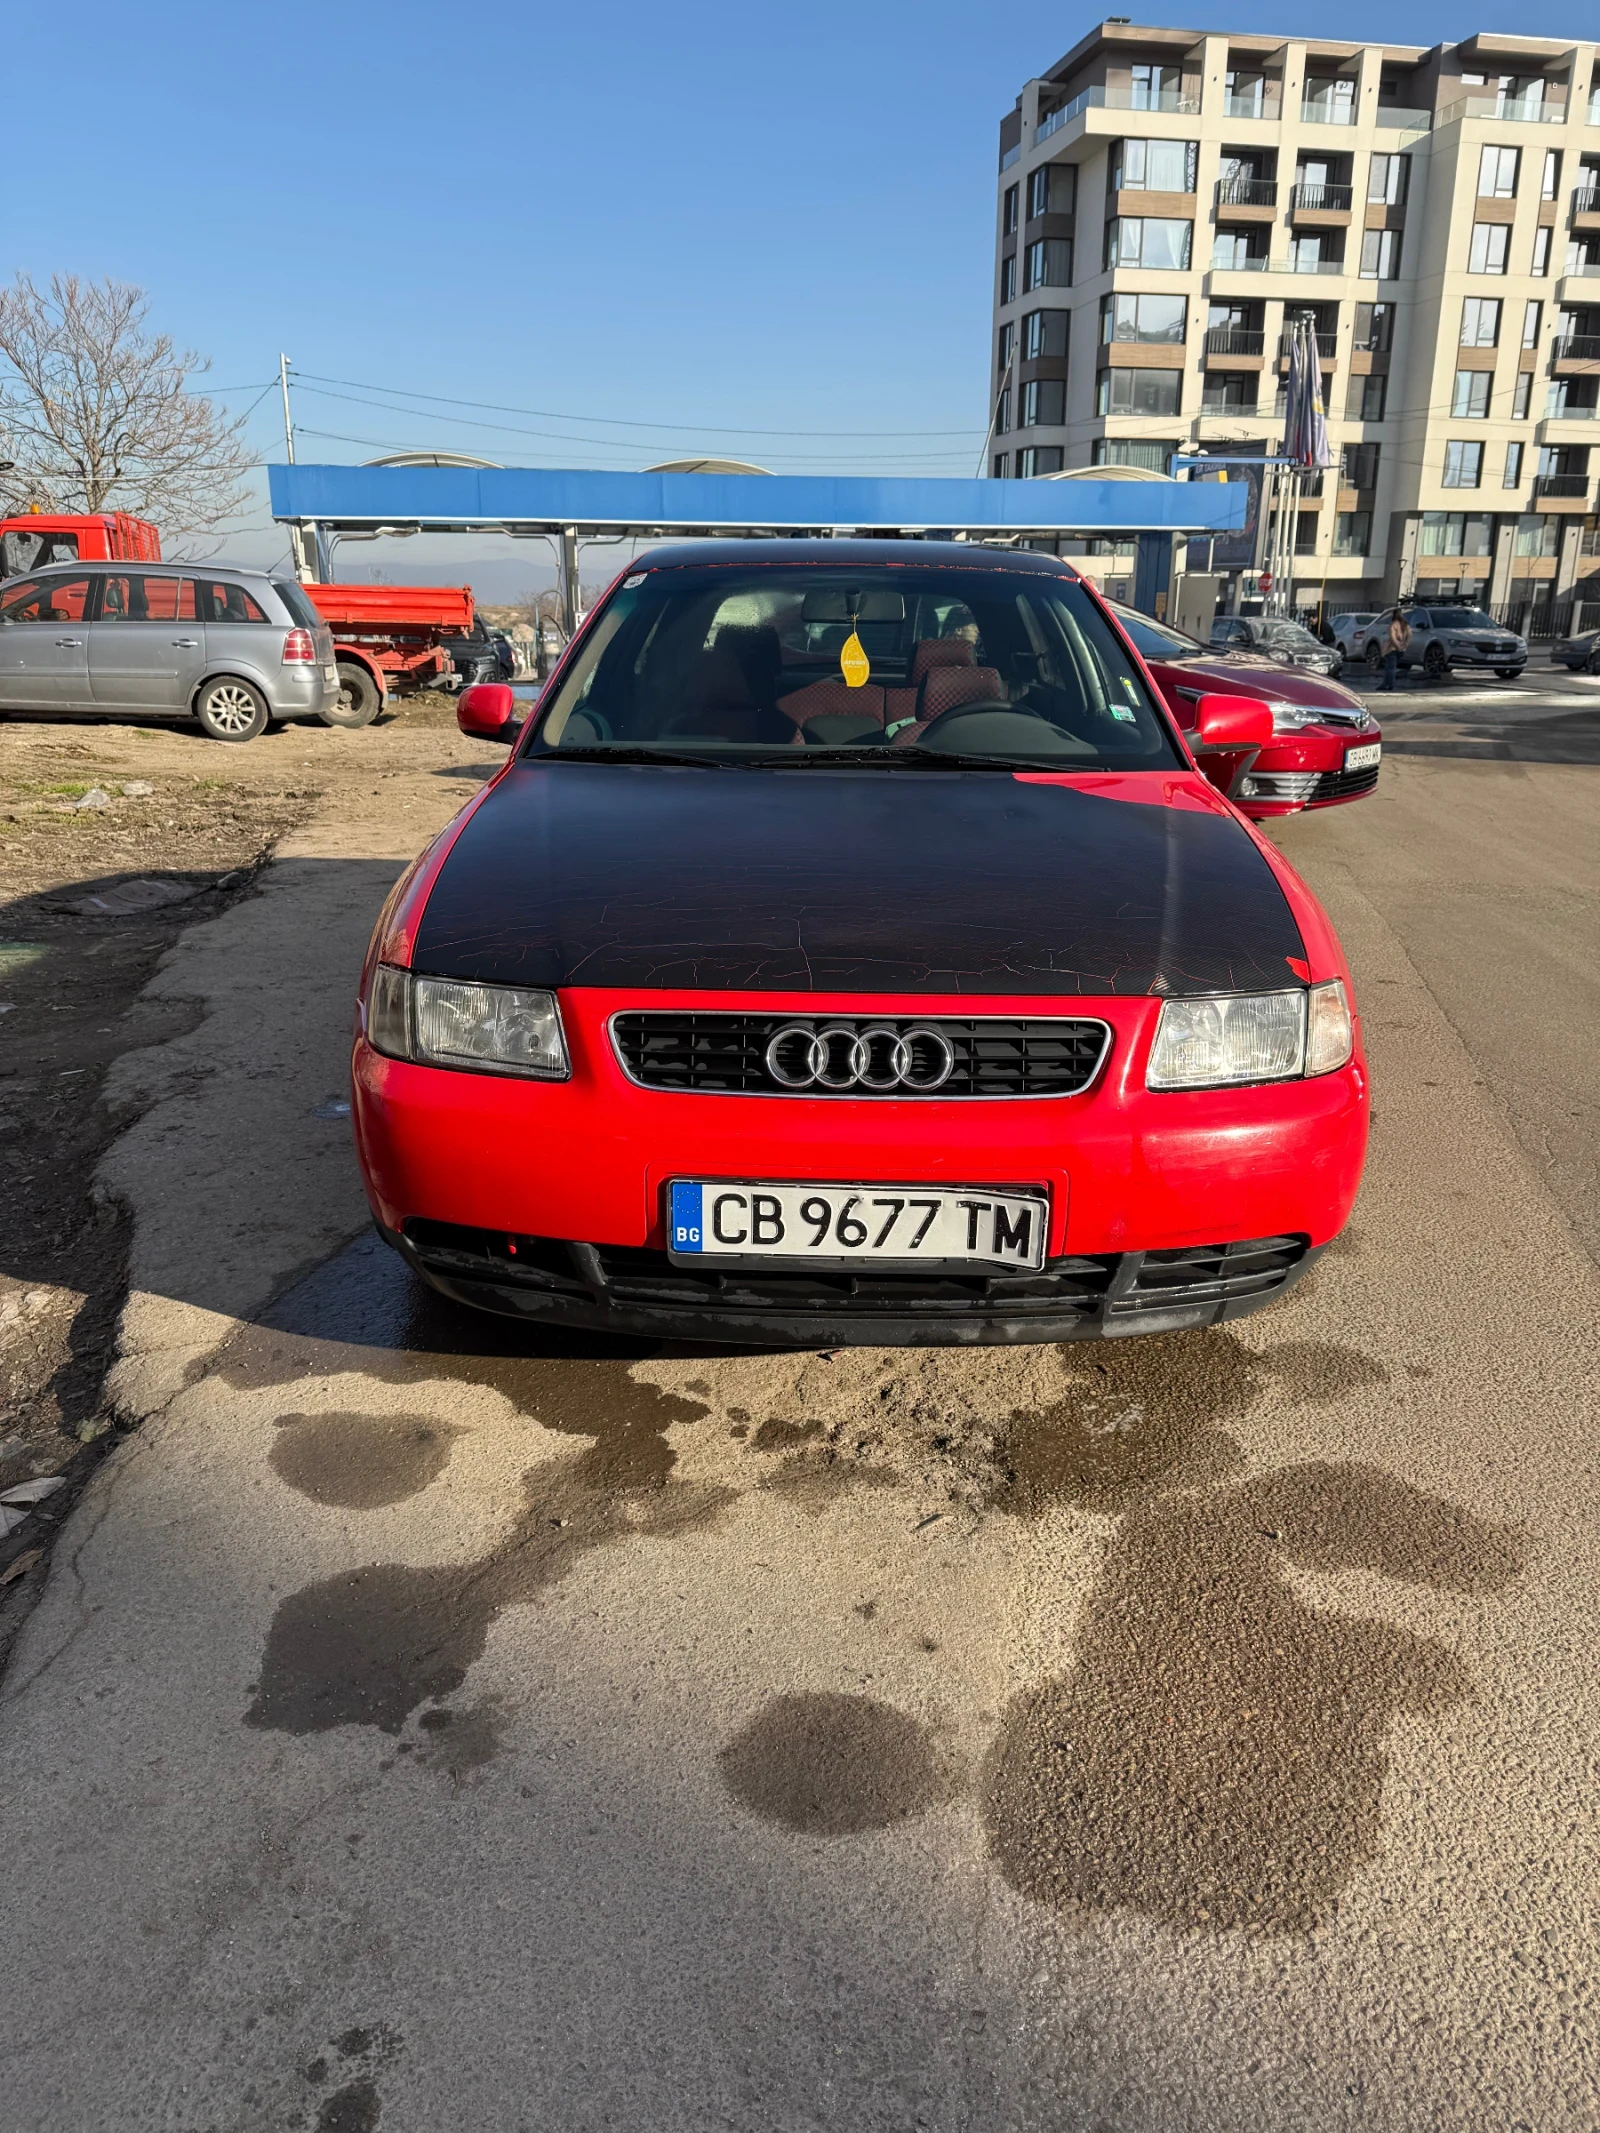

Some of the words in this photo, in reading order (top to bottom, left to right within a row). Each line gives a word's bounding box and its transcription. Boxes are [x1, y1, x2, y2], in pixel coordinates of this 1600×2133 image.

[677, 1227, 700, 1242] BG
[712, 1193, 785, 1245] CB
[799, 1196, 943, 1249] 9677
[956, 1200, 1032, 1259] TM
